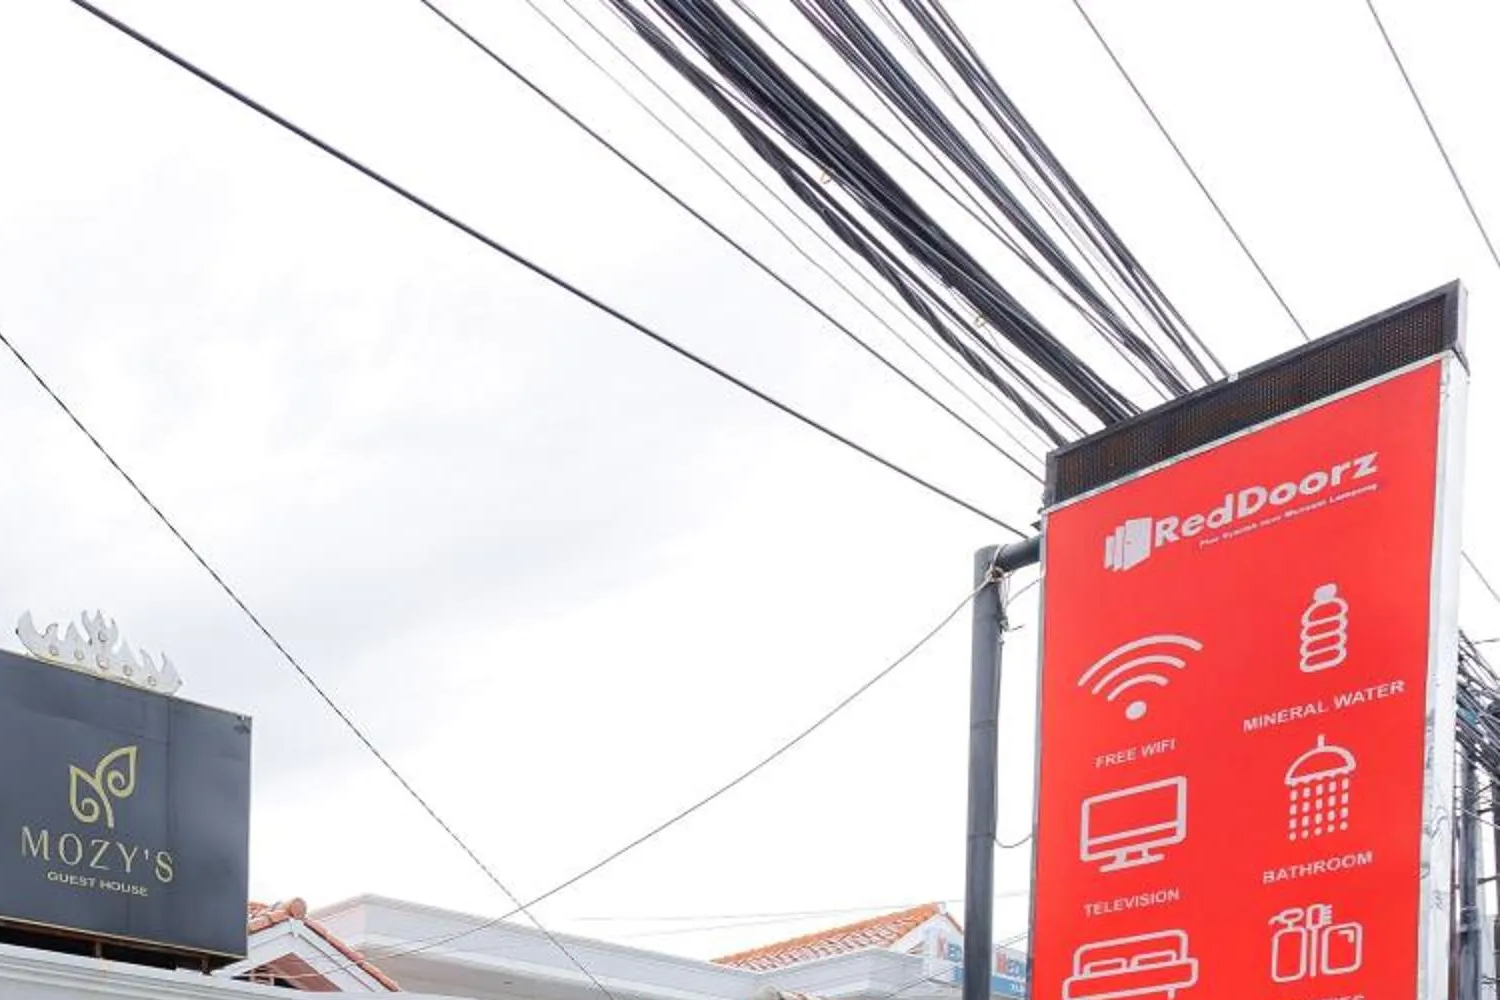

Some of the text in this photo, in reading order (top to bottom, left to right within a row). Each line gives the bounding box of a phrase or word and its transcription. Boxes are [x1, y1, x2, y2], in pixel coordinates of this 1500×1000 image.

[1155, 452, 1378, 547] RedDoorz
[1243, 679, 1405, 733] MINERAL WATER
[1095, 737, 1176, 769] FREE WIFI
[20, 825, 174, 883] MOZY'S
[1262, 850, 1373, 885] BATHROOM
[47, 870, 149, 897] GUEST HOUSE
[1083, 887, 1180, 918] TELEVISION
